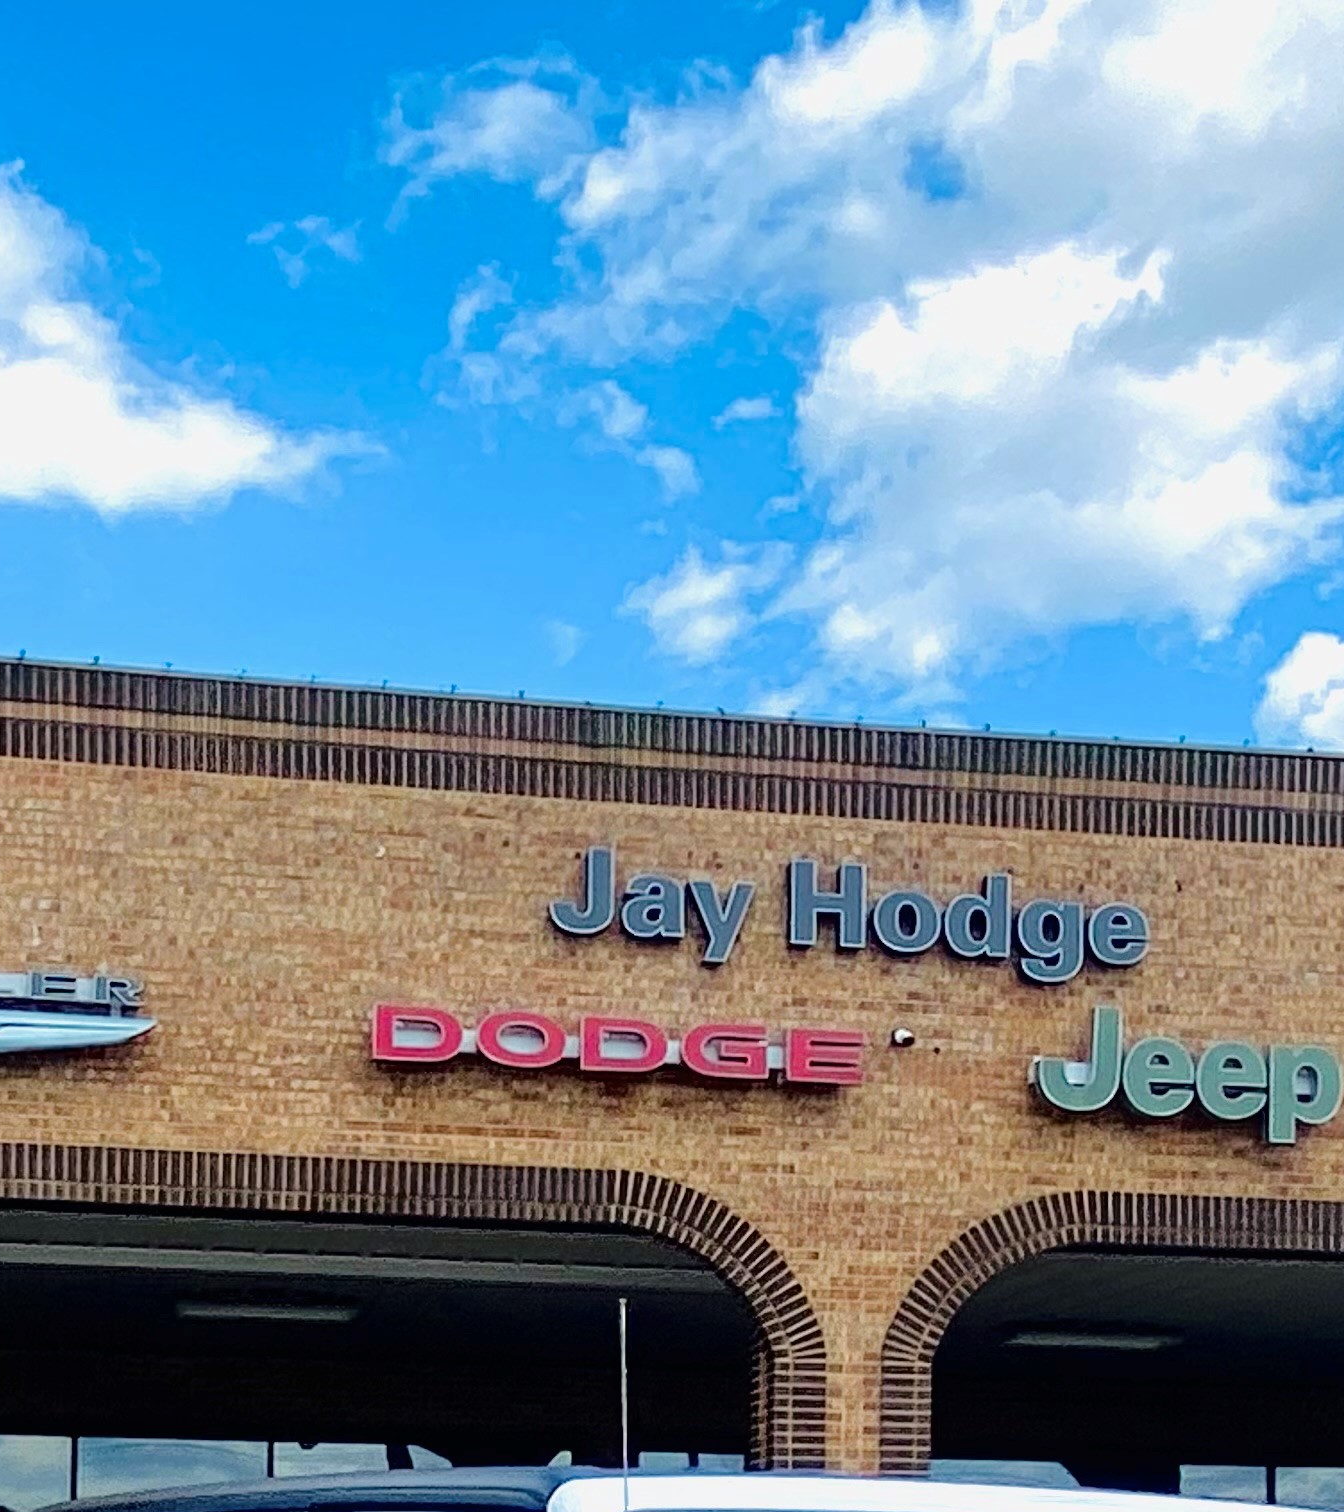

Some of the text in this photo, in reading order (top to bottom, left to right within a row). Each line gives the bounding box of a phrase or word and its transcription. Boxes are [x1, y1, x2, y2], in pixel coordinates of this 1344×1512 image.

[549, 846, 1150, 984] Jay Hodge
[371, 1004, 865, 1085] DODGE
[1030, 1005, 1344, 1144] Jeep
